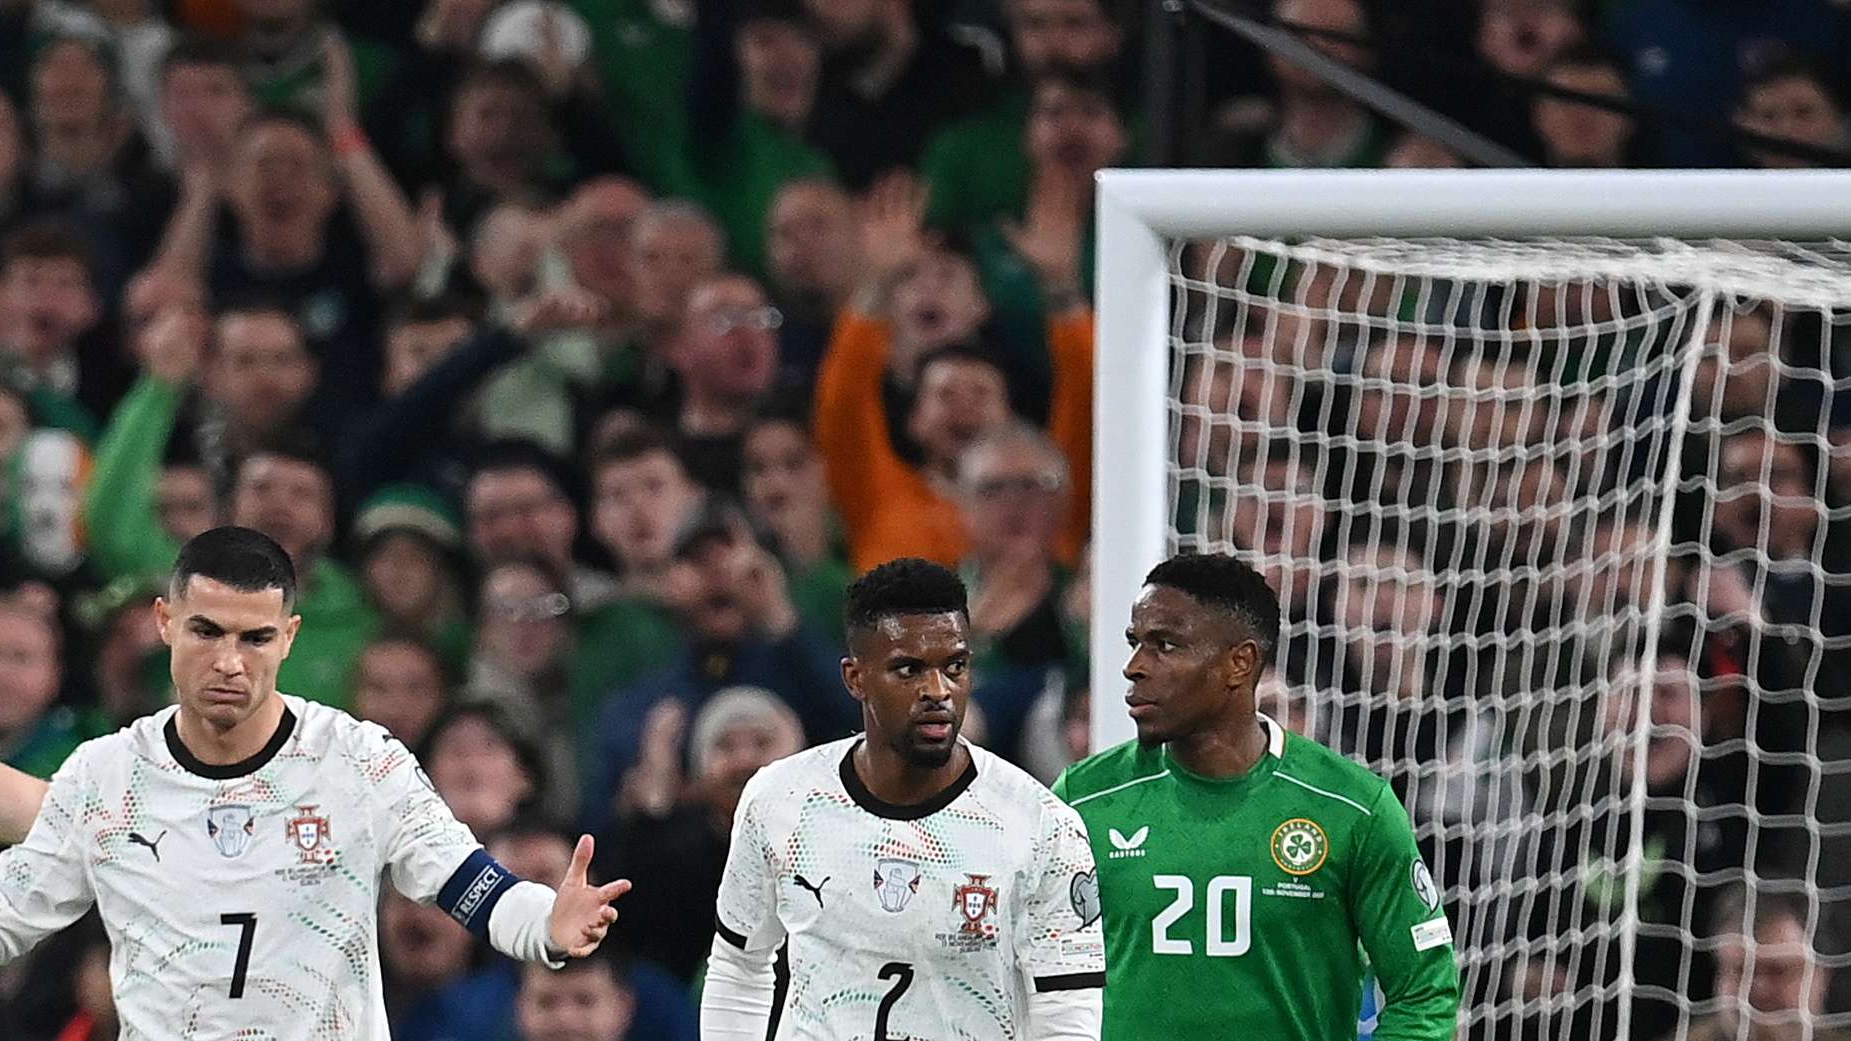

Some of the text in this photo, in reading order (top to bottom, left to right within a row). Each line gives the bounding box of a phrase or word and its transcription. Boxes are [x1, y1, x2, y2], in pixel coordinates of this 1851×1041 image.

[459, 867, 500, 915] RESPECT
[1151, 874, 1253, 957] 20
[220, 911, 258, 999] 7
